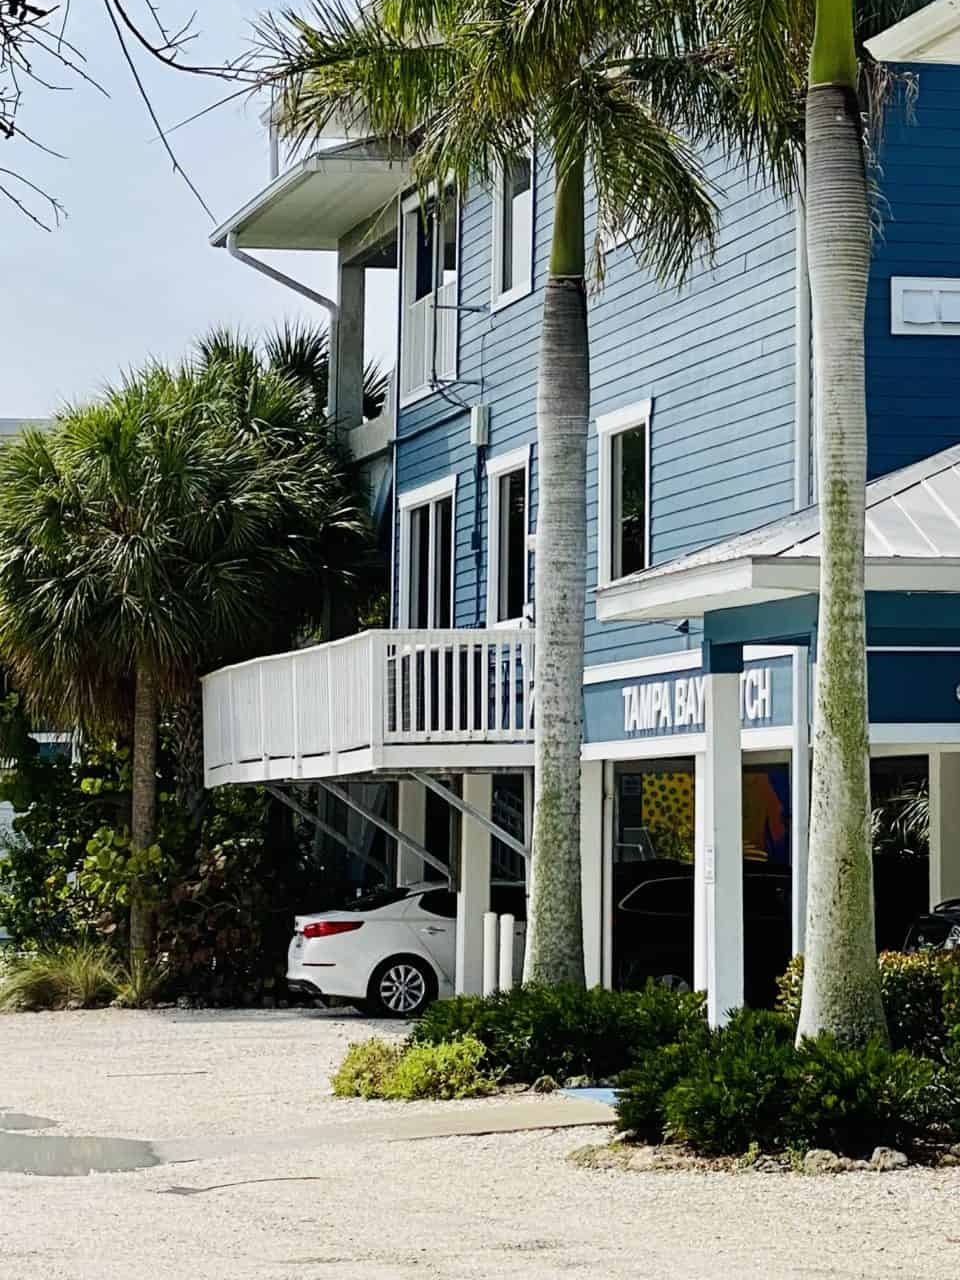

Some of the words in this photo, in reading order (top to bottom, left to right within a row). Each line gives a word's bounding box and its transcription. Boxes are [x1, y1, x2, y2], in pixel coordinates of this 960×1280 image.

[622, 680, 672, 732] TAMPA
[674, 676, 705, 726] BAY
[739, 668, 770, 721] TCH
